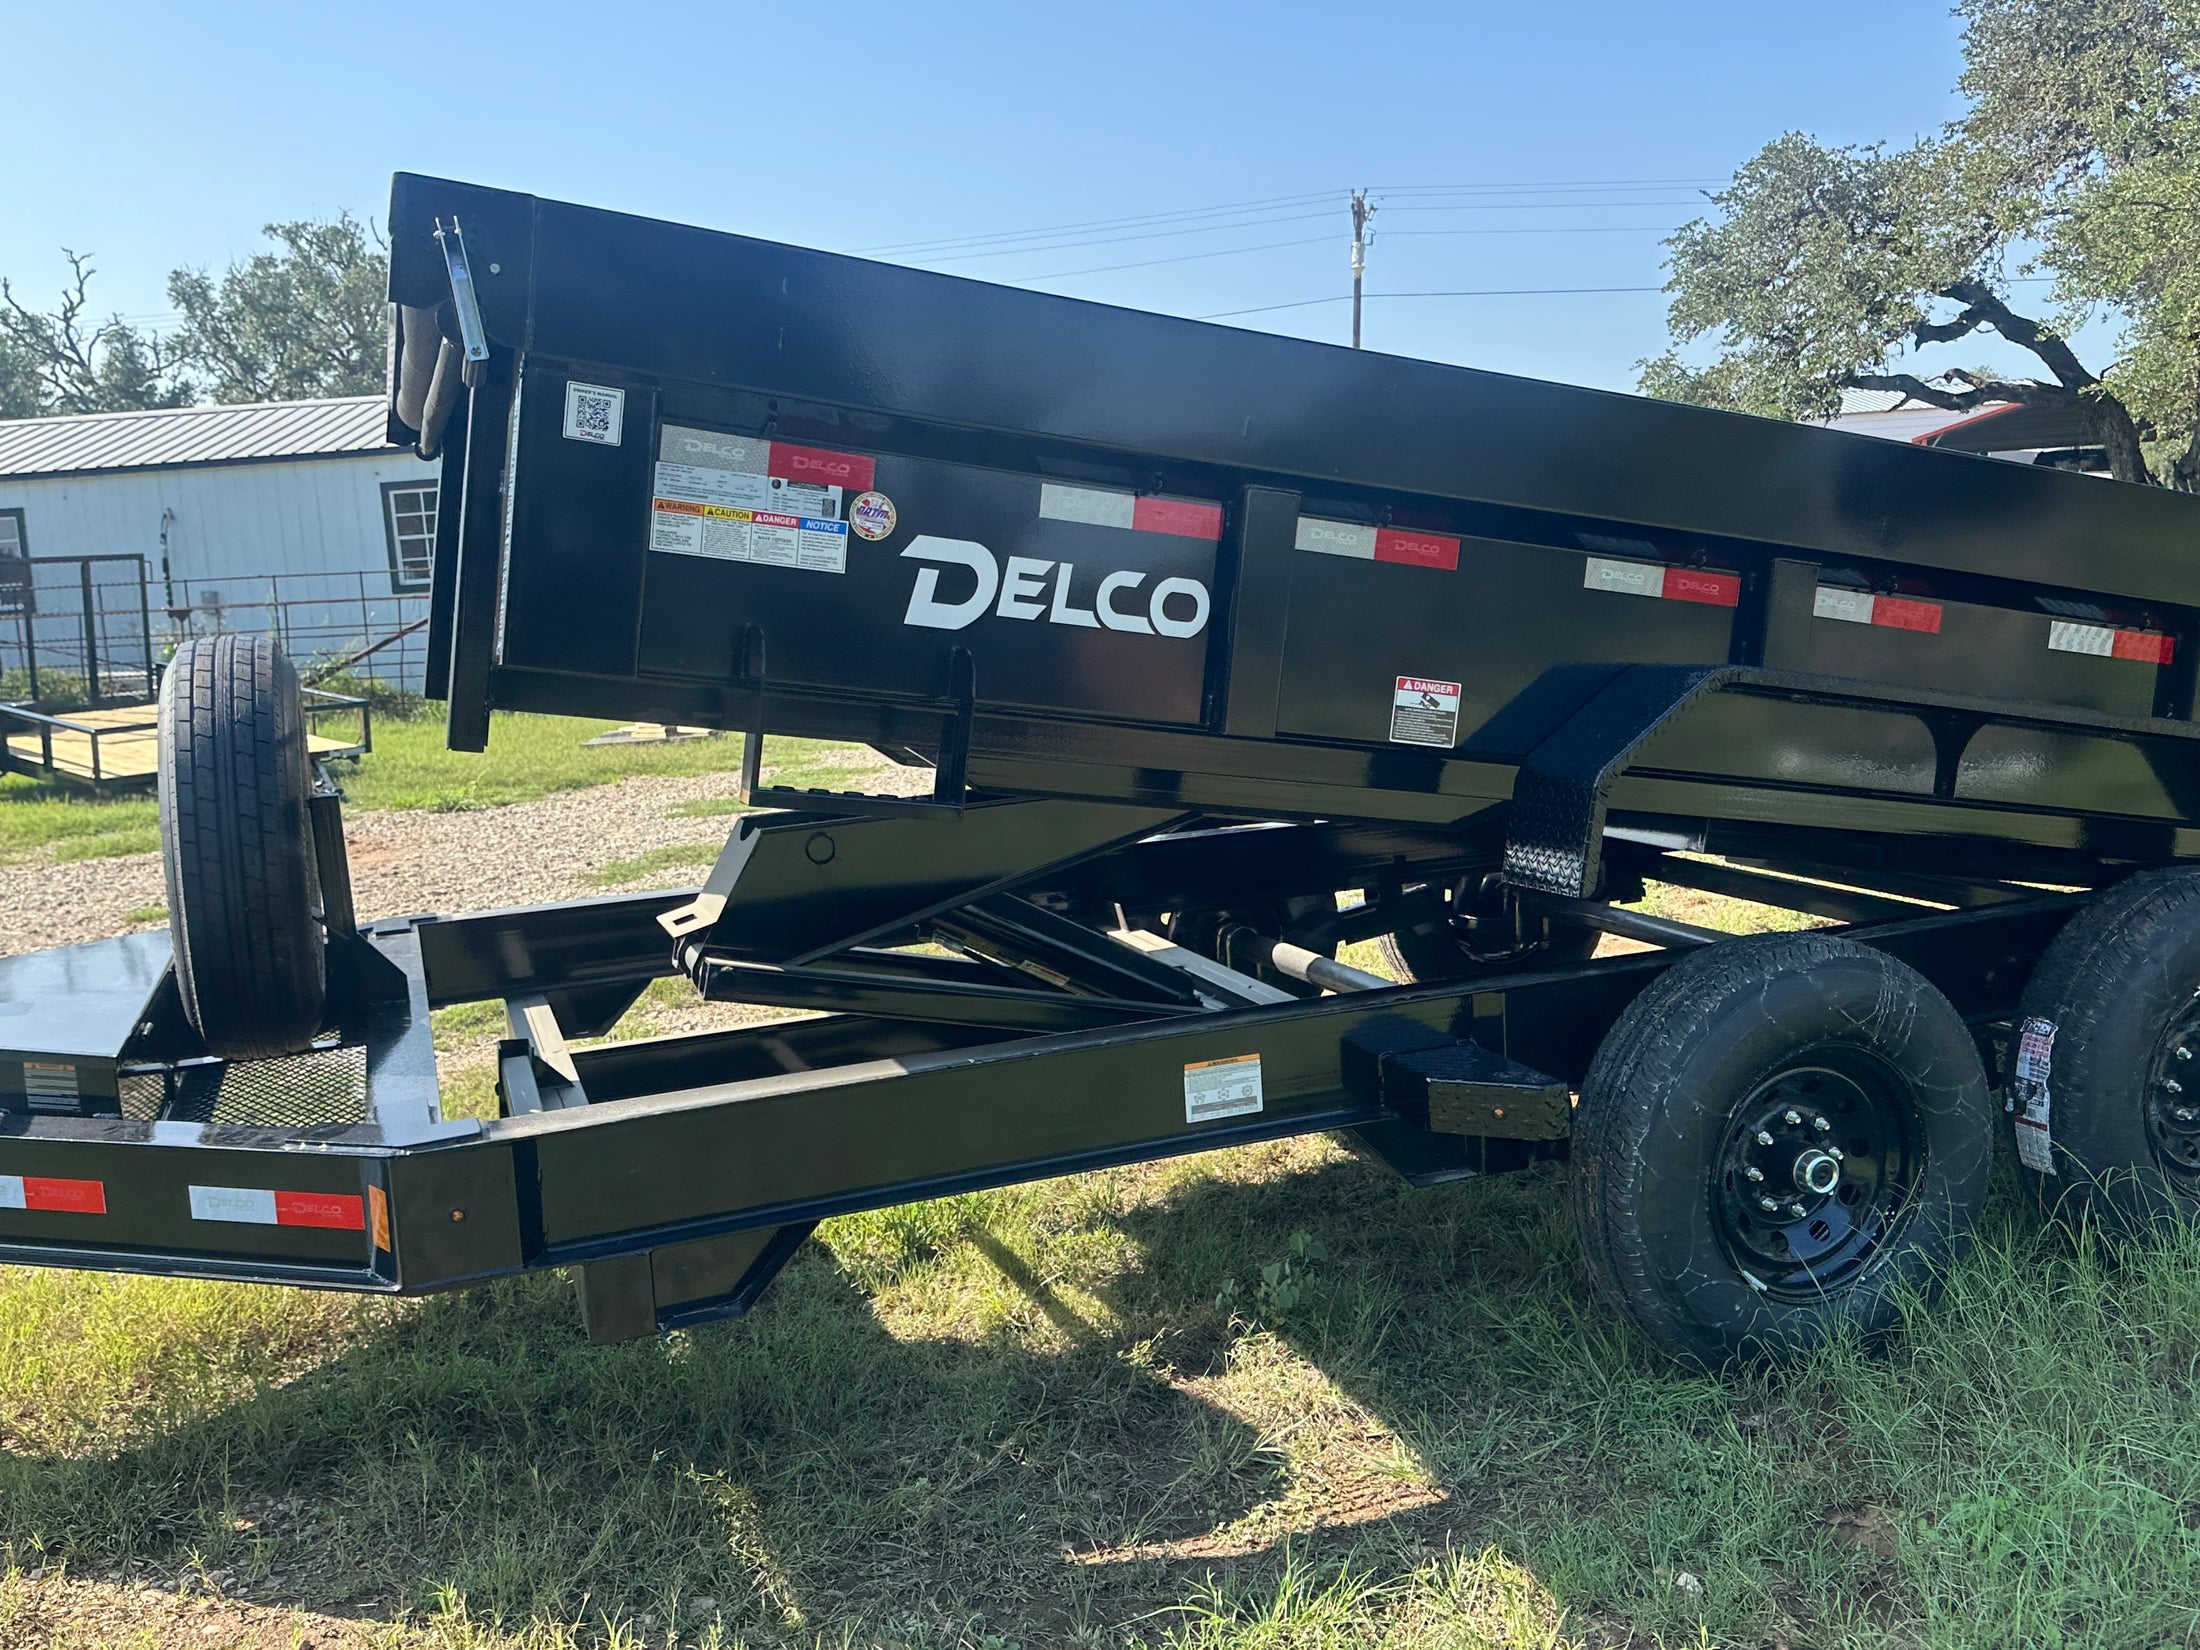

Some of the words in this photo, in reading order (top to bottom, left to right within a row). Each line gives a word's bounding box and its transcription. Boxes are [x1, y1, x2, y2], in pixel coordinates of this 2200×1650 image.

[684, 439, 745, 456] DELCO
[792, 456, 850, 473] DELCO
[665, 502, 700, 514] WARNING
[714, 508, 750, 520] CAUTION
[763, 514, 797, 526] DANGER
[806, 520, 841, 533] NOTICE
[1309, 527, 1357, 543] DELCO
[1394, 539, 1440, 554] DELCO
[1602, 568, 1644, 583] DELCO
[900, 534, 1211, 639] DELCO
[1677, 579, 1720, 592] DELCO
[1414, 681, 1454, 695] DANGER
[205, 1196, 256, 1210] DELCO
[290, 1201, 342, 1215] DELCO
